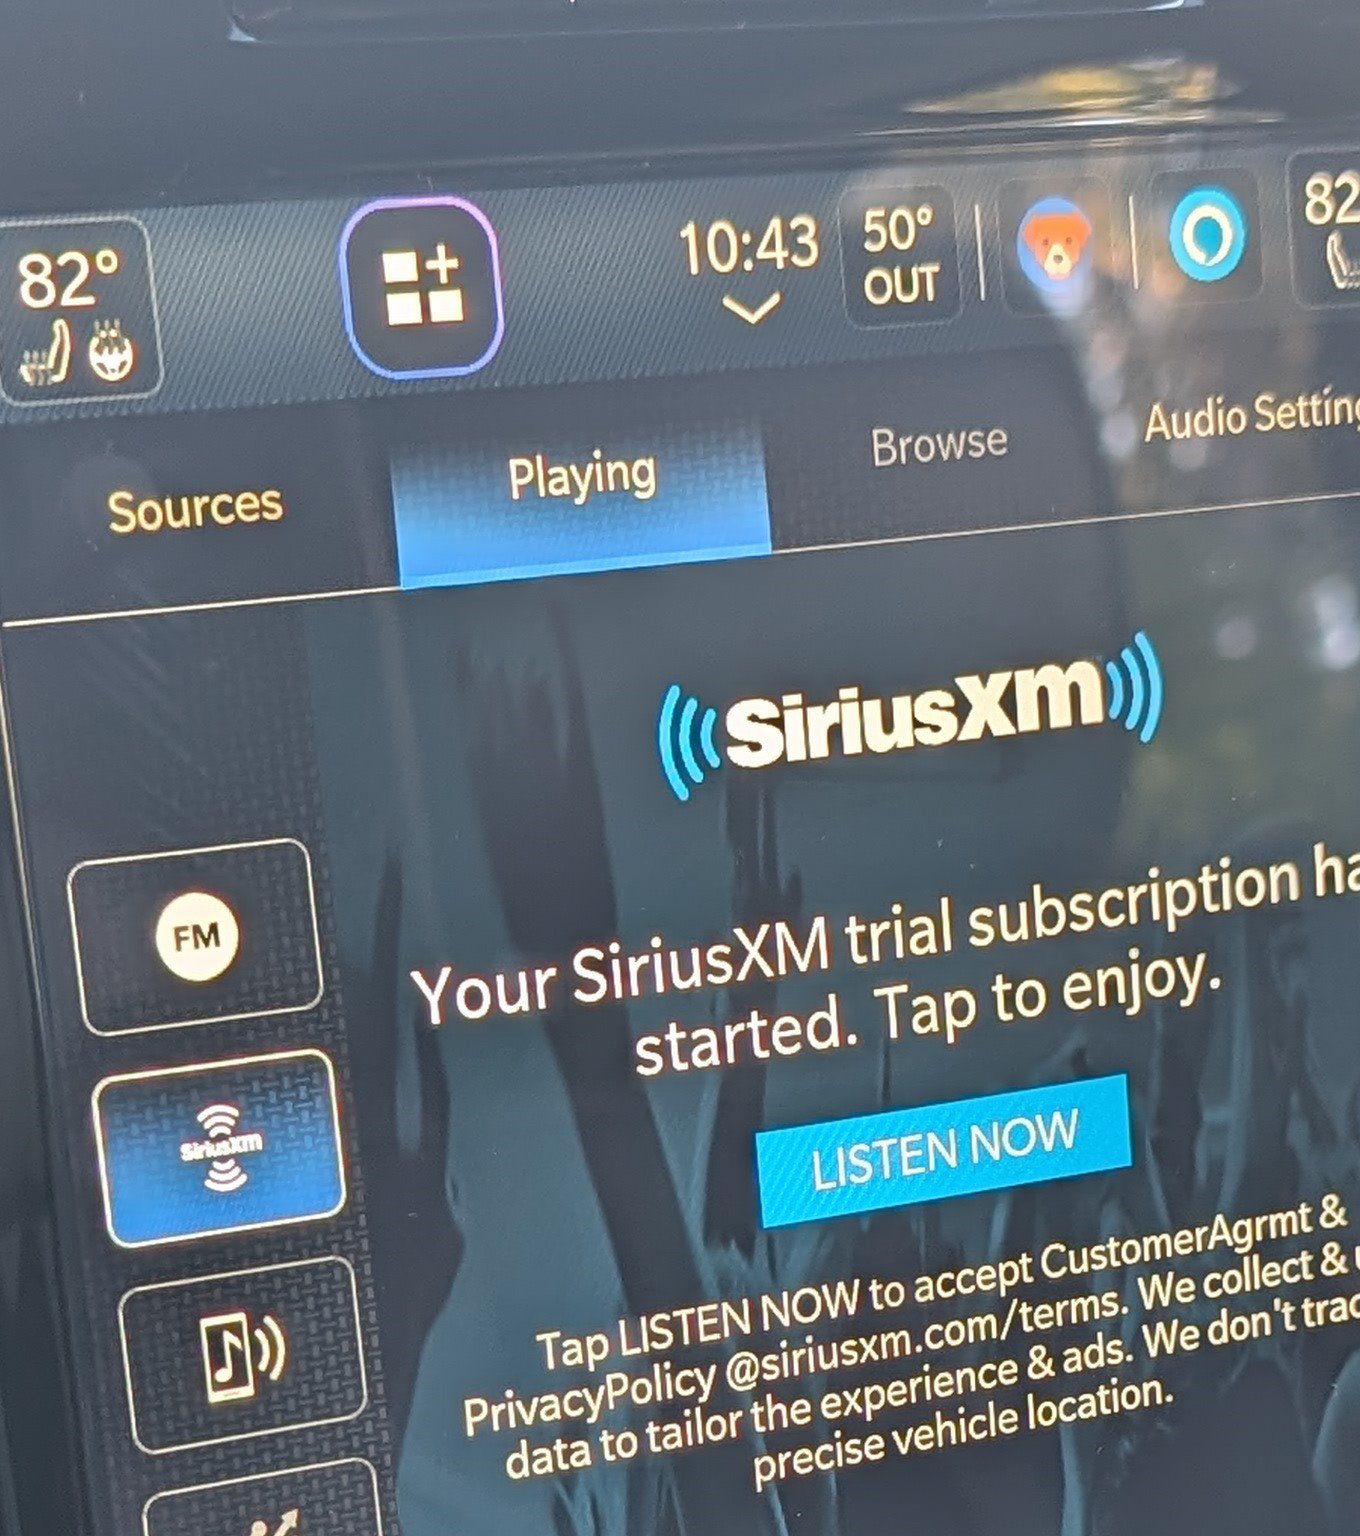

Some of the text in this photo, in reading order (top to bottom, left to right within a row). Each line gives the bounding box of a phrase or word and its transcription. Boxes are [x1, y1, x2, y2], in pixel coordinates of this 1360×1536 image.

[679, 213, 821, 276] 10:43
[863, 204, 934, 254] 50°
[19, 250, 120, 310] 82°
[863, 263, 940, 306] OUT
[871, 425, 1009, 469] Browse
[1144, 395, 1248, 444] Audio
[508, 450, 657, 505] Playing
[108, 484, 285, 535] Sources
[173, 921, 221, 952] FM
[410, 964, 557, 1026] Your
[572, 915, 830, 1005] SiriusXM
[844, 896, 952, 965] trial
[968, 855, 1301, 949] subscription
[636, 947, 1222, 1076] started. Tap to enjoy.
[812, 1107, 1080, 1192] LISTEN NOW
[535, 1193, 1348, 1373] Tap LISTEN NOW to accept CustomerAgrmt &
[464, 1362, 718, 1438] PrivacyPolicy
[726, 1289, 1130, 1393] @siriusxm.com/terms.
[1138, 1271, 1196, 1311] We
[1203, 1250, 1314, 1297] collect
[1320, 1241, 1349, 1278] &
[505, 1436, 592, 1480] data
[600, 1428, 638, 1462] to
[646, 1407, 743, 1453] tailor
[751, 1394, 811, 1435] the
[820, 1356, 1018, 1421] experience
[1027, 1343, 1056, 1382] &
[1062, 1331, 1134, 1375] ads.
[1141, 1320, 1200, 1360] We
[1208, 1298, 1297, 1346] don't
[753, 1377, 1174, 1493] precise vehicle location.
